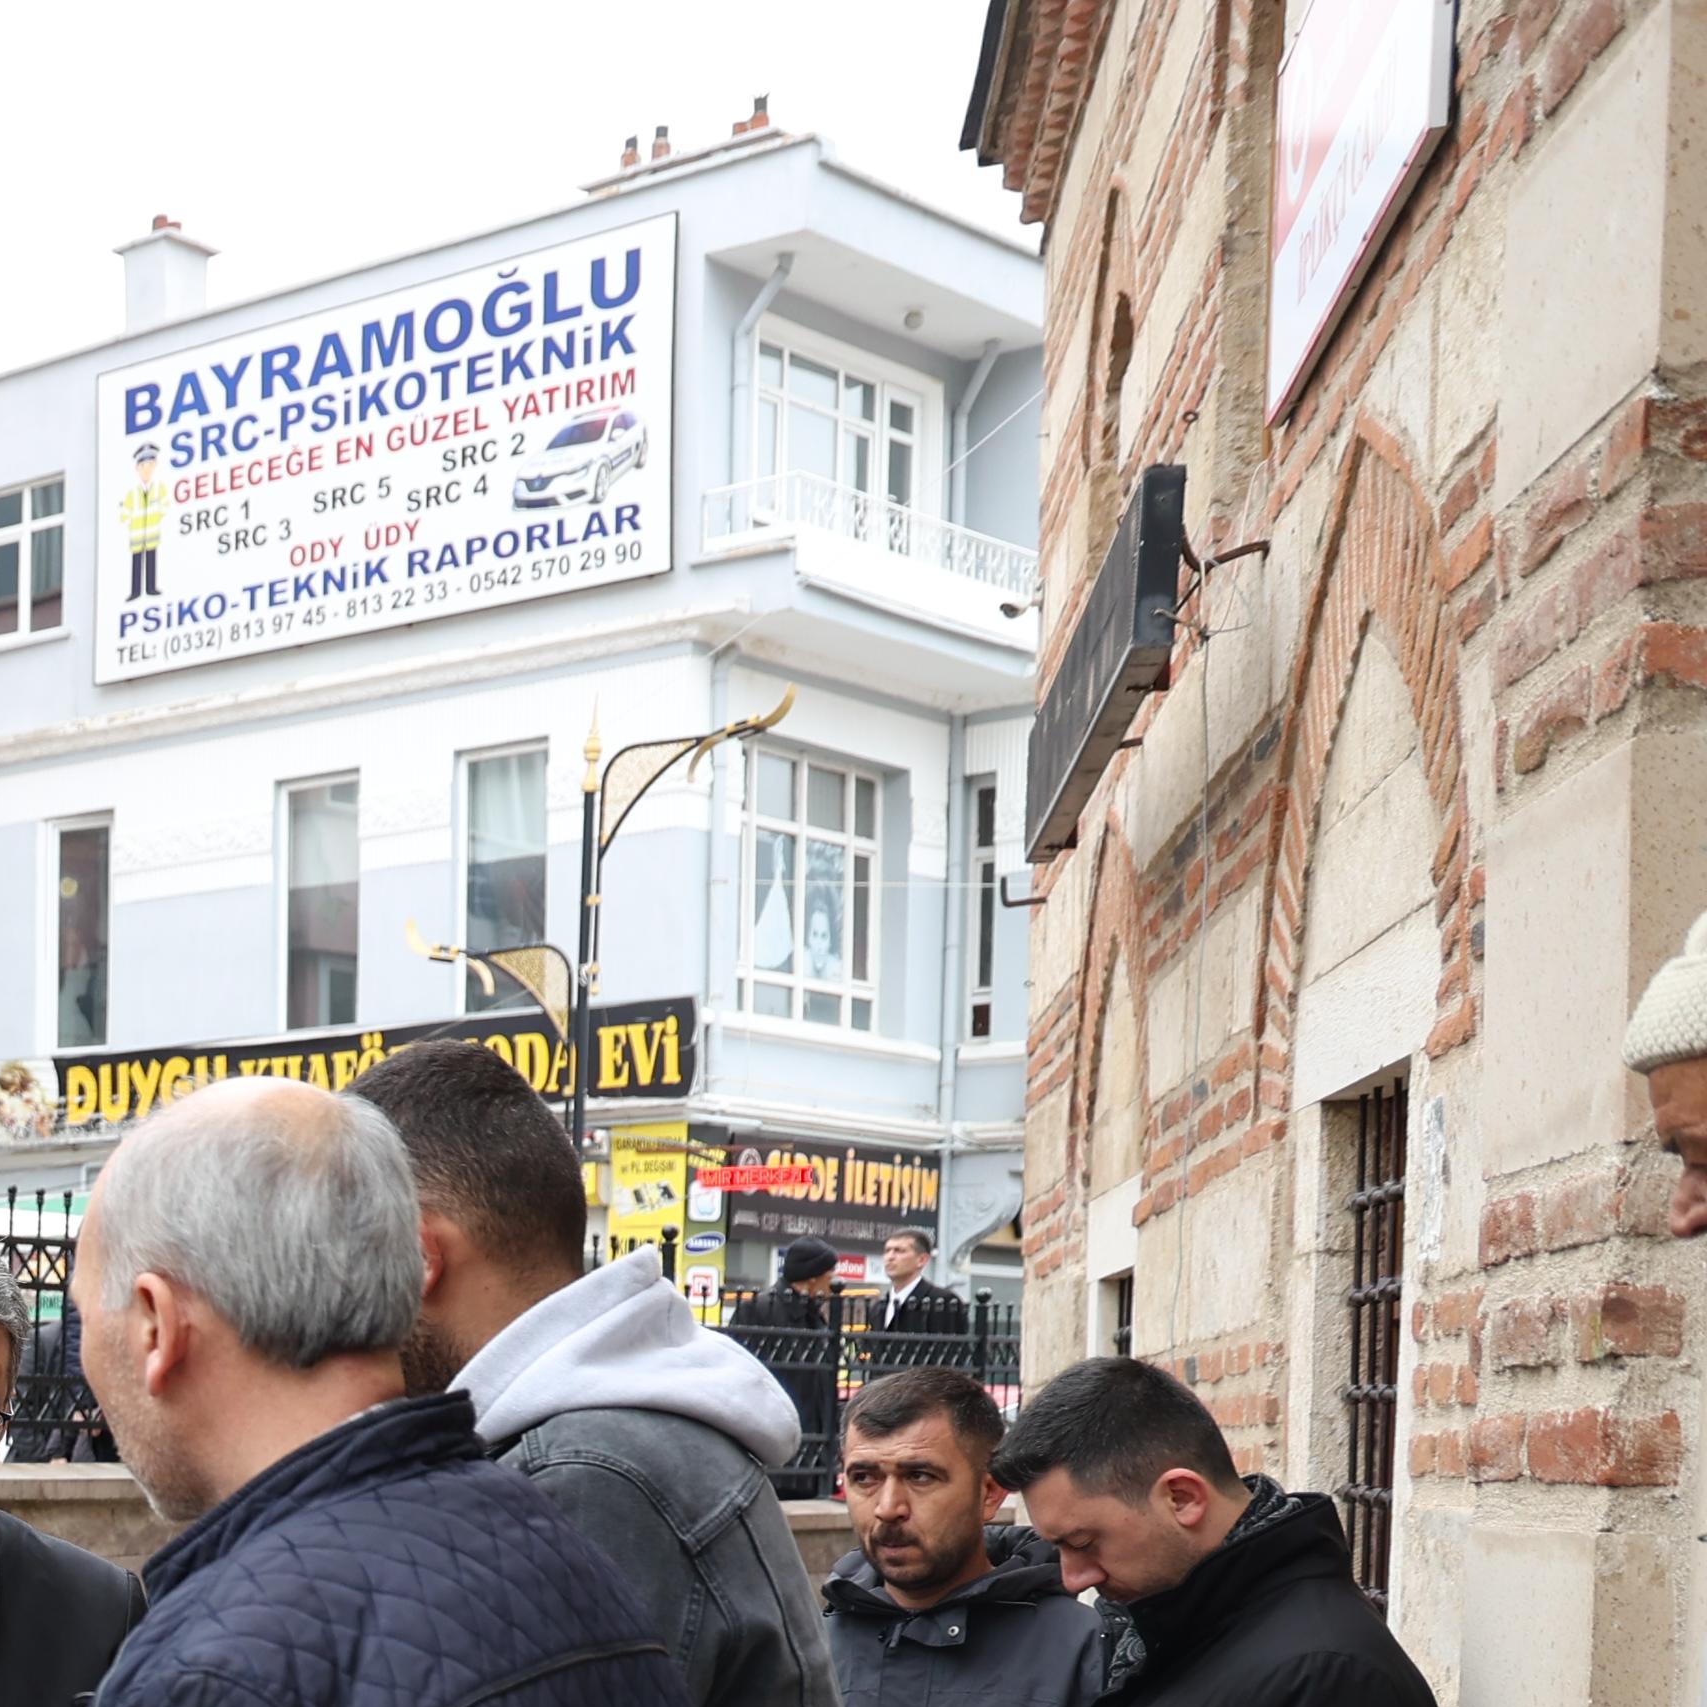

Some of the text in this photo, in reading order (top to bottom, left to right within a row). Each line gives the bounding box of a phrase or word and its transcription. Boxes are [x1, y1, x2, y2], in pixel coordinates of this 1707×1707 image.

[125, 247, 642, 436] BAYRAMOĞLU
[173, 367, 635, 504] GELECEĞE EN GÜZEL YATIRIM
[442, 431, 526, 472] SRC 2
[179, 499, 251, 536] SRC 1
[313, 475, 392, 514] SRC 5
[407, 474, 489, 512] SRC 4
[217, 518, 292, 555] SRC 3
[289, 517, 421, 568] ODY ÜDY
[406, 503, 642, 578] RAPORLAR
[117, 644, 157, 665] TEL:
[164, 627, 224, 660] (0332)
[230, 619, 265, 643] 813
[272, 612, 294, 634] 97
[302, 605, 326, 626] 45
[346, 593, 383, 619] 813
[391, 587, 415, 611] 22
[424, 580, 449, 604] 33
[469, 564, 522, 594] 0542
[531, 555, 571, 581] 570
[579, 547, 606, 571] 29
[614, 540, 642, 564] 90
[843, 1147, 939, 1217] İLETİŞİM
